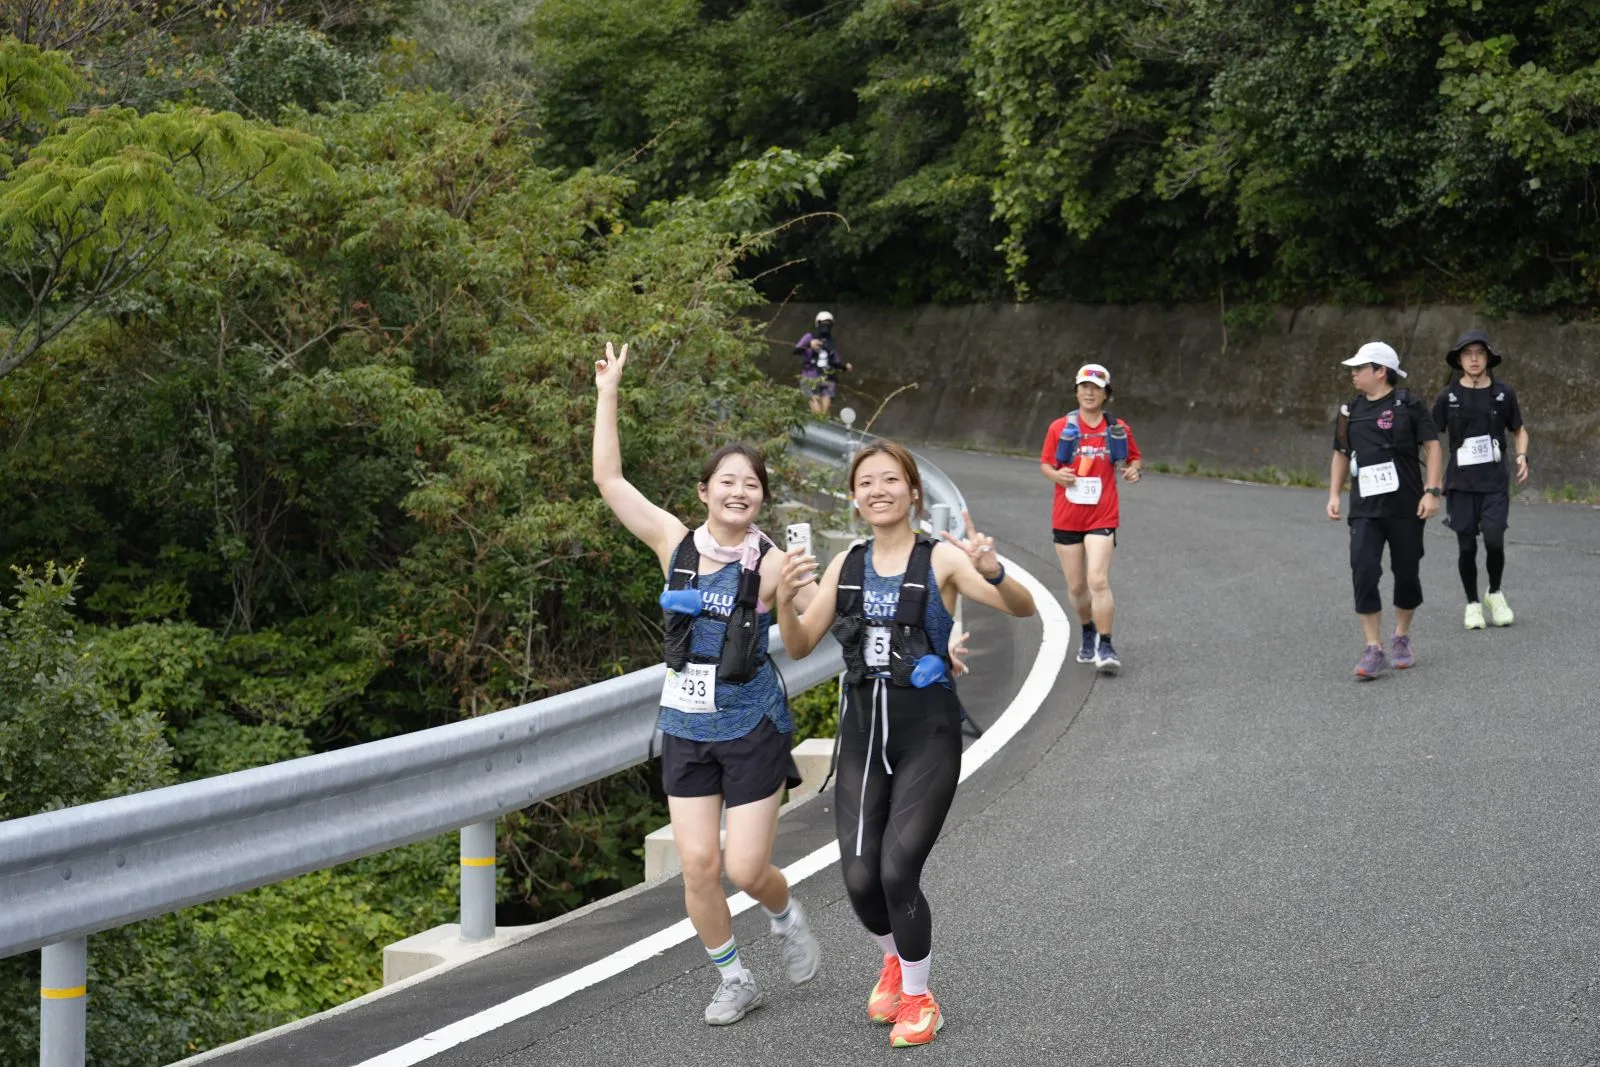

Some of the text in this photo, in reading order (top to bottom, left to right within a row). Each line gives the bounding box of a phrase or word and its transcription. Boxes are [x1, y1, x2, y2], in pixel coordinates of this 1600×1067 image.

[1471, 443, 1489, 455] 395
[1374, 471, 1393, 484] 141
[1084, 485, 1097, 495] 39
[702, 591, 734, 607] ULU
[874, 636, 884, 655] 5
[681, 677, 706, 697] 493
